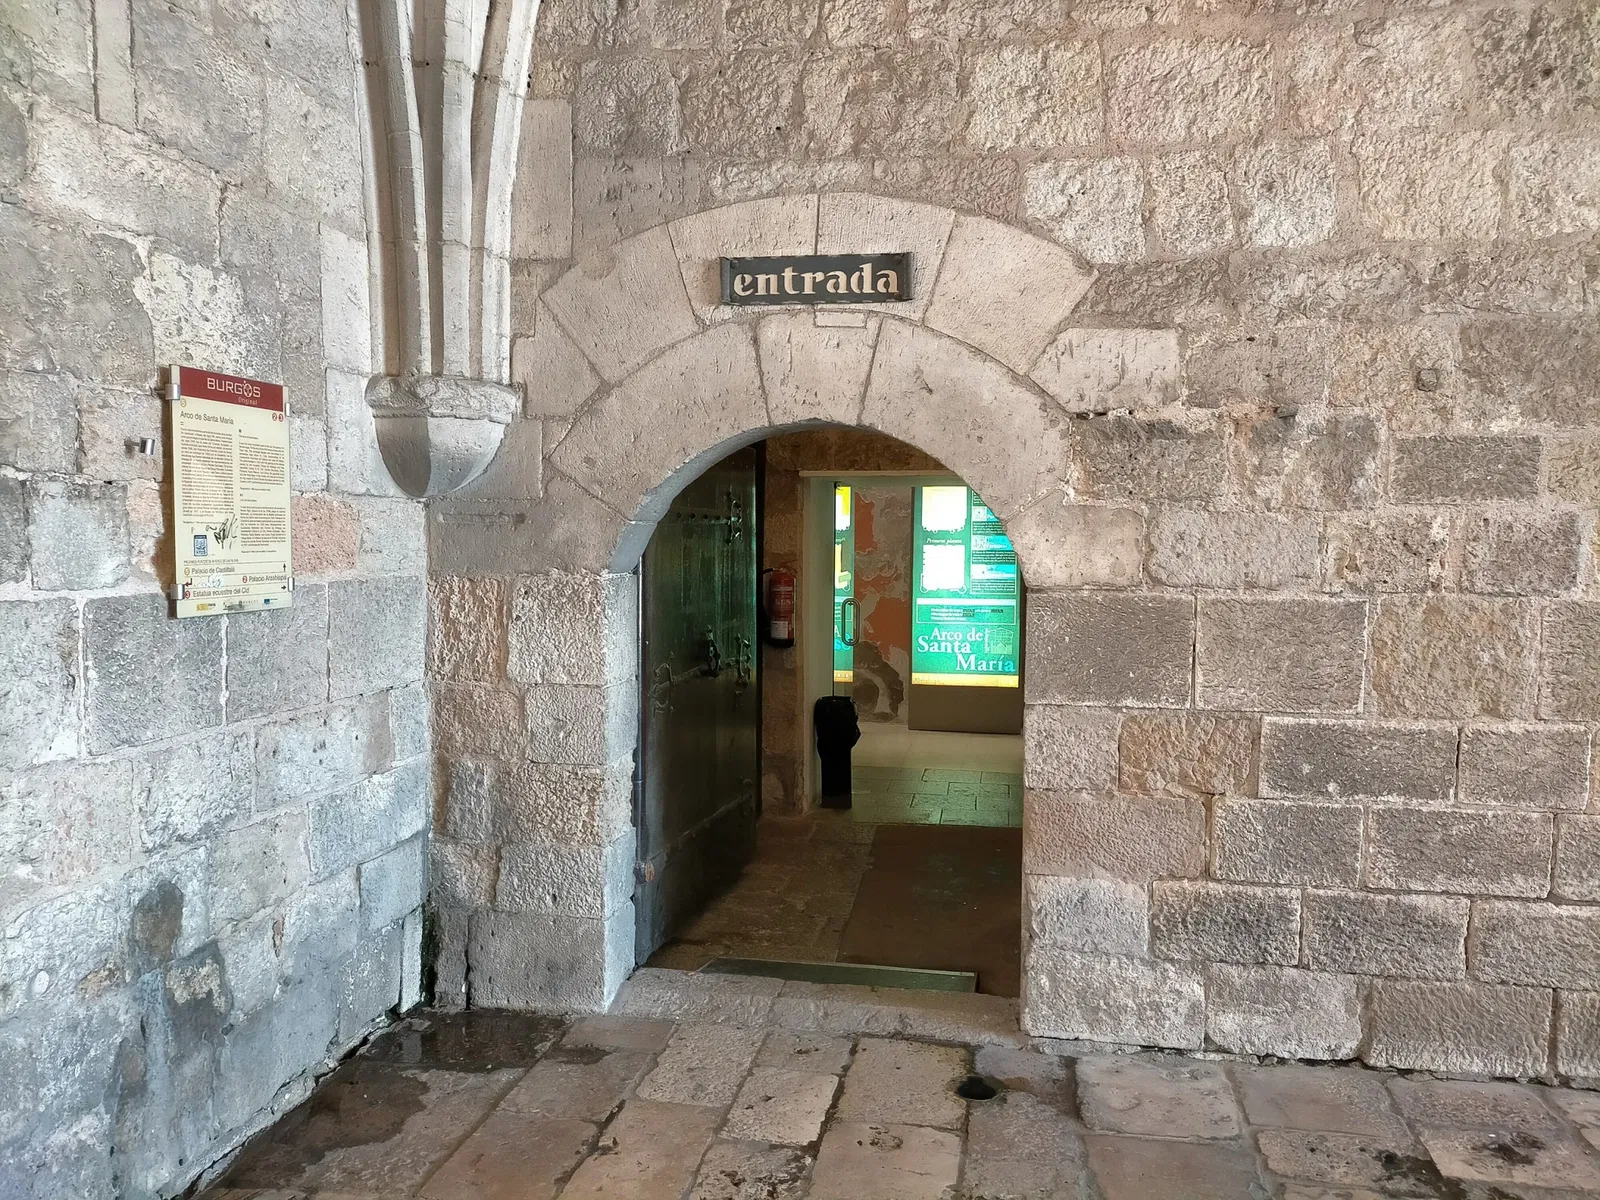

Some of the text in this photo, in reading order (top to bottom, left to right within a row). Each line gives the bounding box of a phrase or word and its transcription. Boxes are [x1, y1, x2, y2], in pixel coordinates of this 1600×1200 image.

[734, 262, 899, 296] entrada
[207, 377, 261, 398] BURGOS
[180, 410, 194, 420] Arco
[194, 412, 203, 421] de
[203, 413, 219, 423] Santa
[192, 567, 208, 575] Palacio
[248, 575, 265, 583] Palacio
[193, 590, 212, 598] Estatua
[930, 627, 963, 642] Arco
[966, 627, 983, 642] de
[917, 635, 972, 654] Santa
[955, 654, 1016, 673] María
